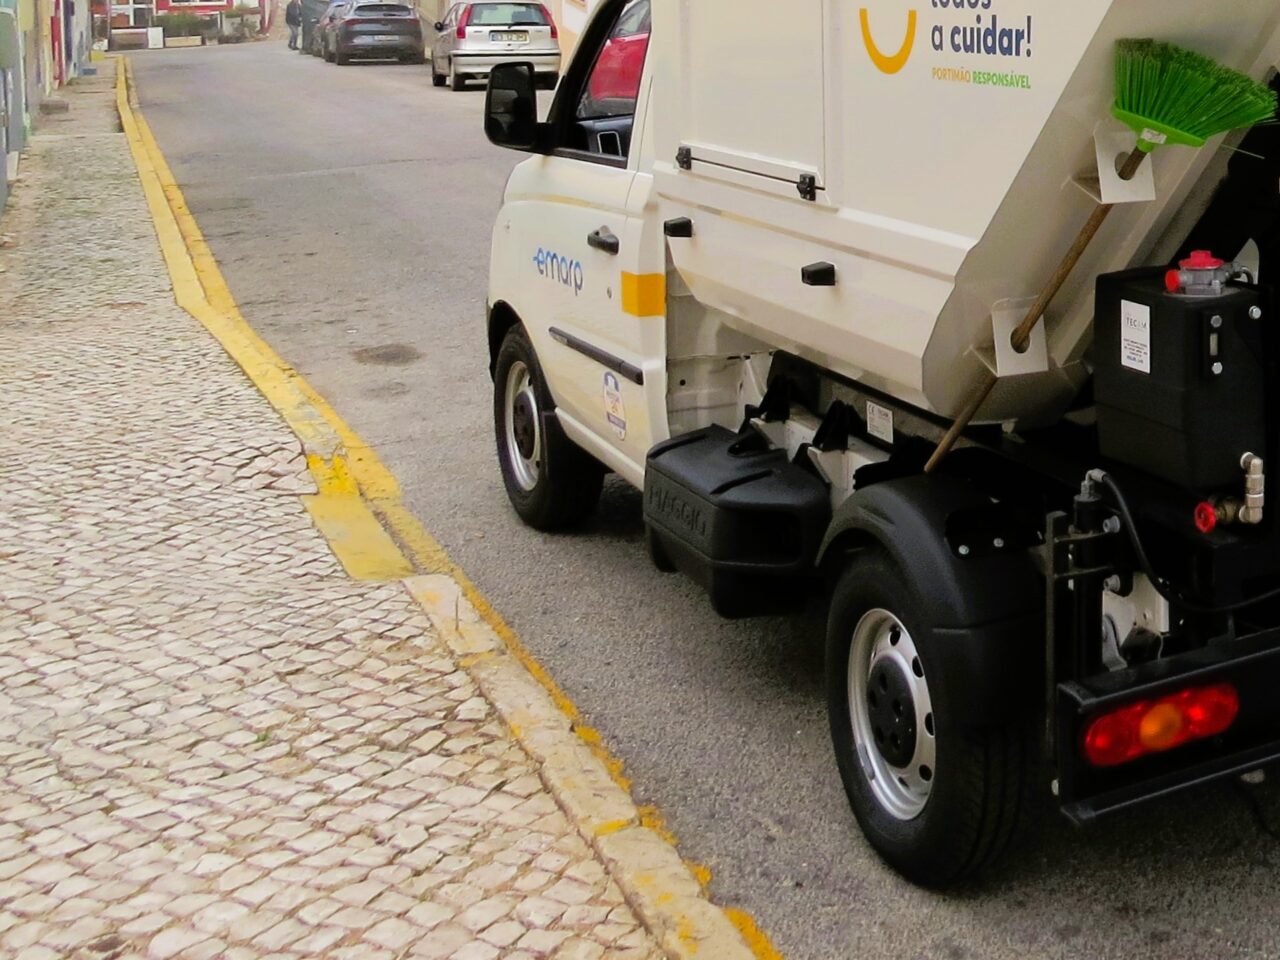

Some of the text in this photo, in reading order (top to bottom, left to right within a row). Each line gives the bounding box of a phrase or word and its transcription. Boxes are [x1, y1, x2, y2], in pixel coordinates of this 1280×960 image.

[931, 14, 1032, 57] a cuidar!
[932, 66, 1031, 89] PORTIMÃO RESPONSÁVEL
[533, 247, 583, 296] emarp
